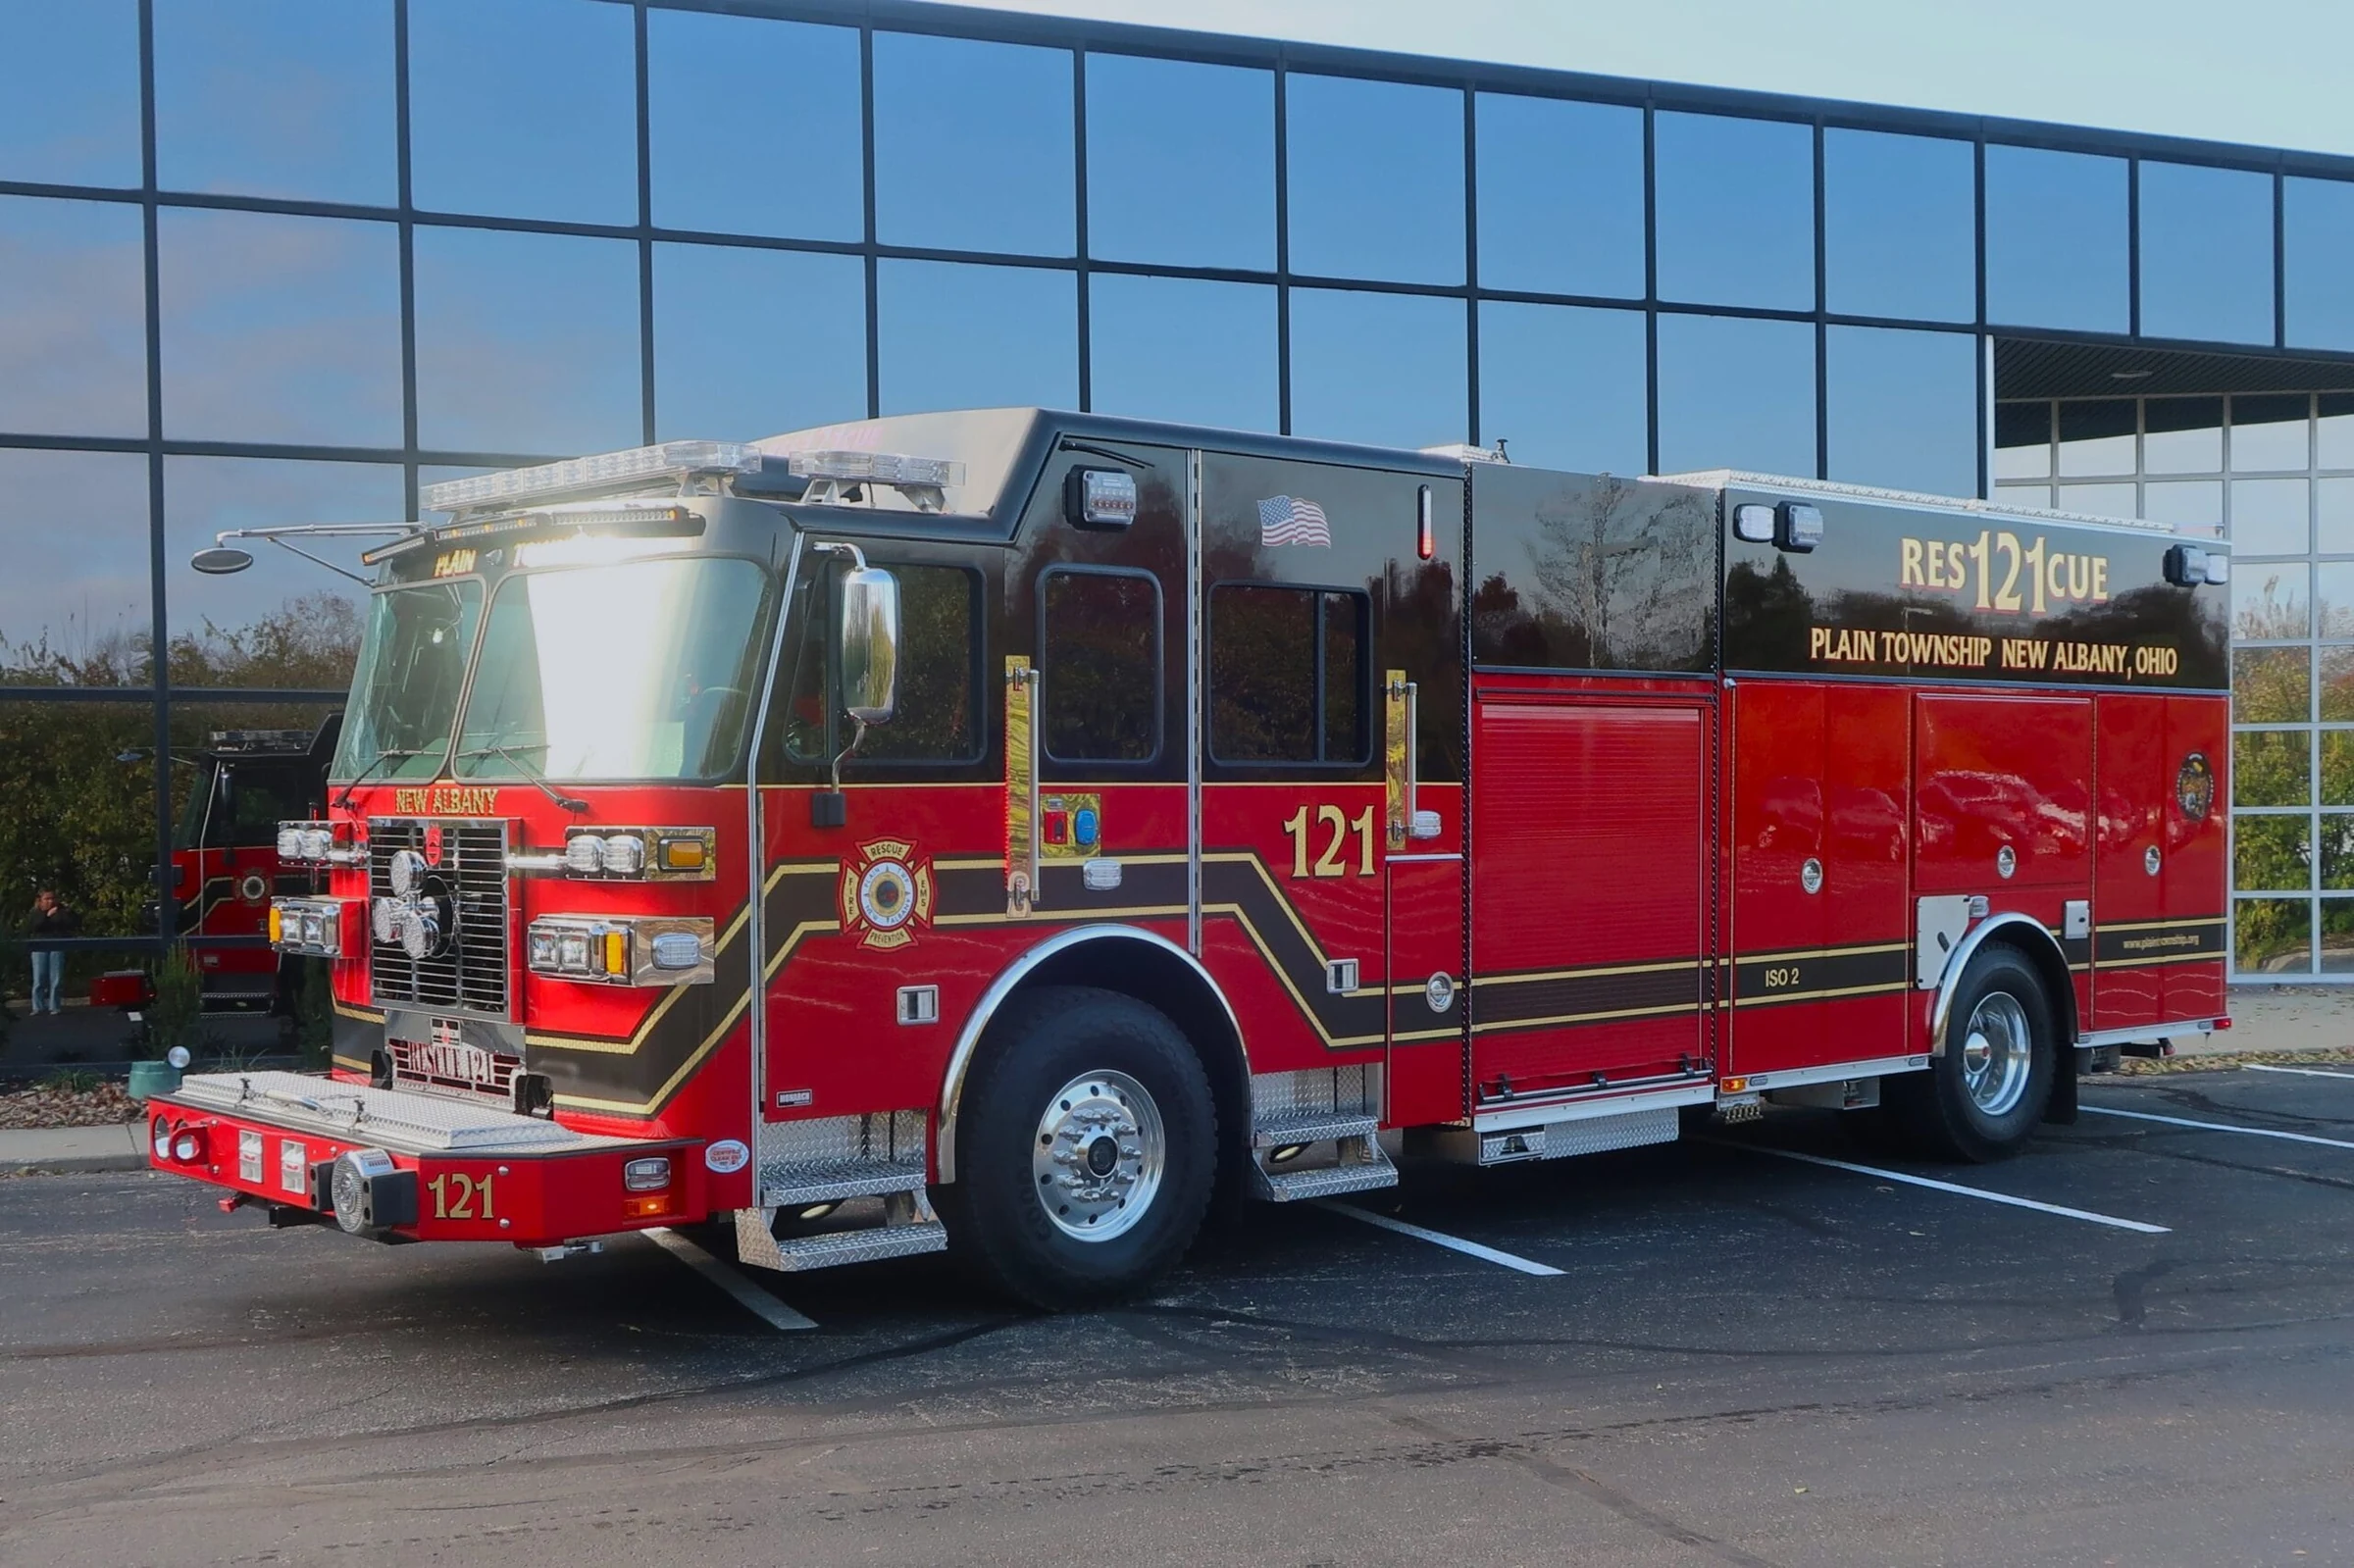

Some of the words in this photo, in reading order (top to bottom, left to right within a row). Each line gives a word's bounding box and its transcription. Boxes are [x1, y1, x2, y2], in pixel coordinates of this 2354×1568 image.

[434, 548, 477, 578] PLAIN
[1811, 628, 1876, 662] PLAIN
[1881, 632, 1992, 667] TOWNSHIP
[2001, 638, 2050, 670] NEW
[2053, 641, 2132, 681] ALBANY,
[2134, 646, 2177, 676] OHIO
[395, 788, 430, 814] NEW
[432, 788, 499, 815] ALBANY
[870, 844, 902, 857] RESCUE
[1283, 804, 1376, 878] 121
[864, 868, 880, 887] PLAIN
[870, 931, 905, 943] PREVENTION
[1766, 968, 1788, 987] ISO
[1791, 967, 1800, 986] 2
[408, 1041, 464, 1079] RESCUE
[467, 1049, 493, 1084] 121
[427, 1173, 494, 1219] 121
